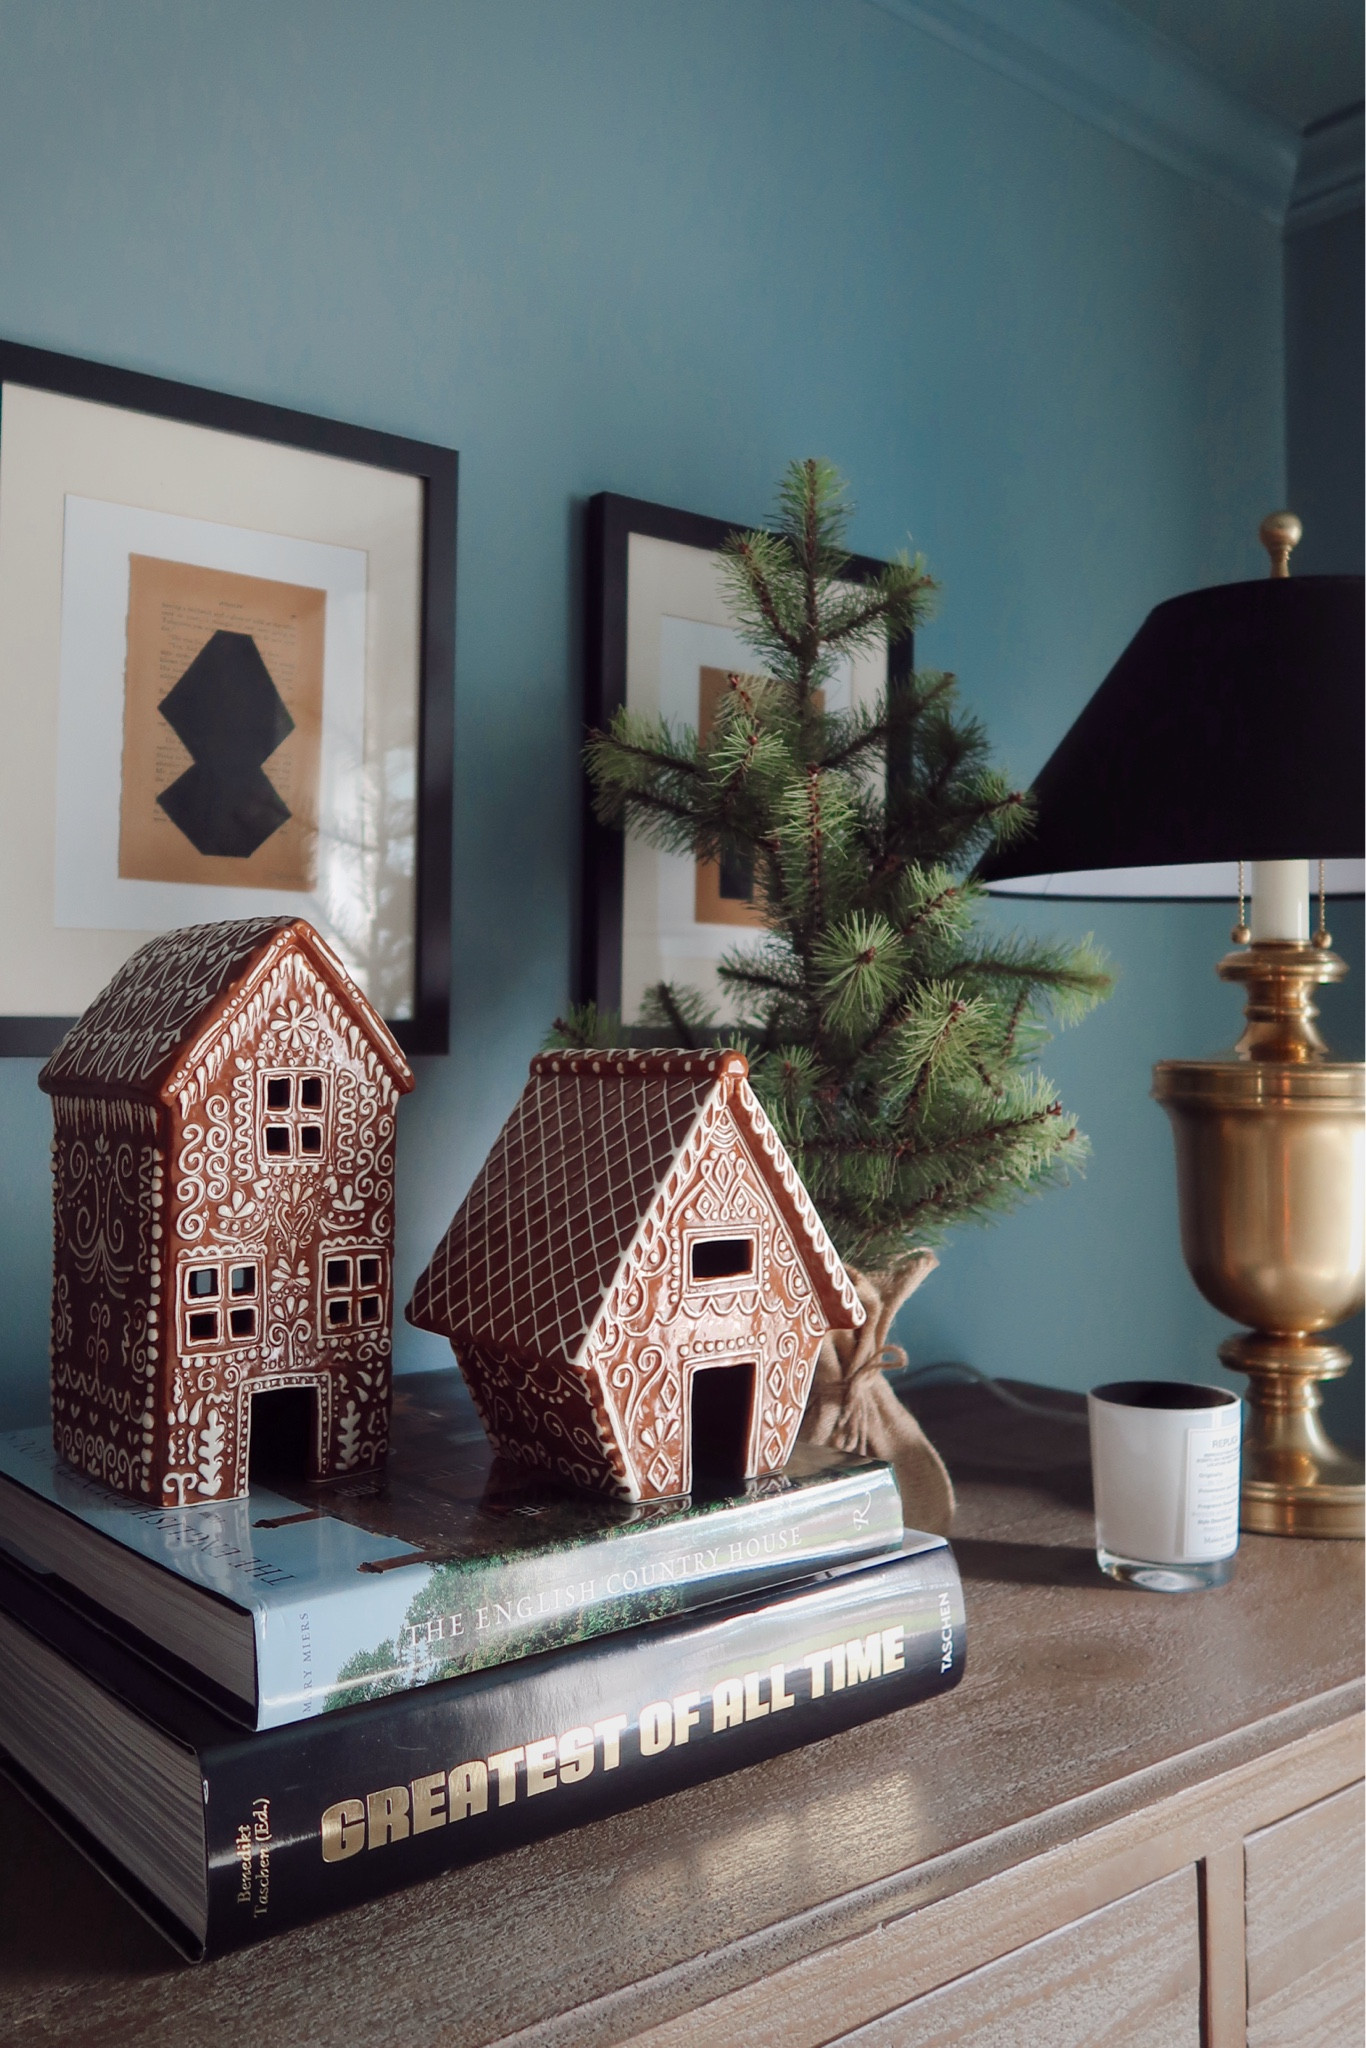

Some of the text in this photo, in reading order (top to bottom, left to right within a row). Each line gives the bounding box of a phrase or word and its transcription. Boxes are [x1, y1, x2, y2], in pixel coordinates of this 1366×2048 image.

[229, 1556, 296, 1586] THE
[406, 1527, 803, 1647] THE ENGLISH COUNTRY HOUSE
[300, 1612, 311, 1662] MIERS
[938, 1591, 953, 1674] TASCHEN
[320, 1625, 906, 1864] GREATEST OF ALL TIME
[236, 1824, 252, 1904] Benedikt
[252, 1798, 272, 1919] Taschen (Ed.)
